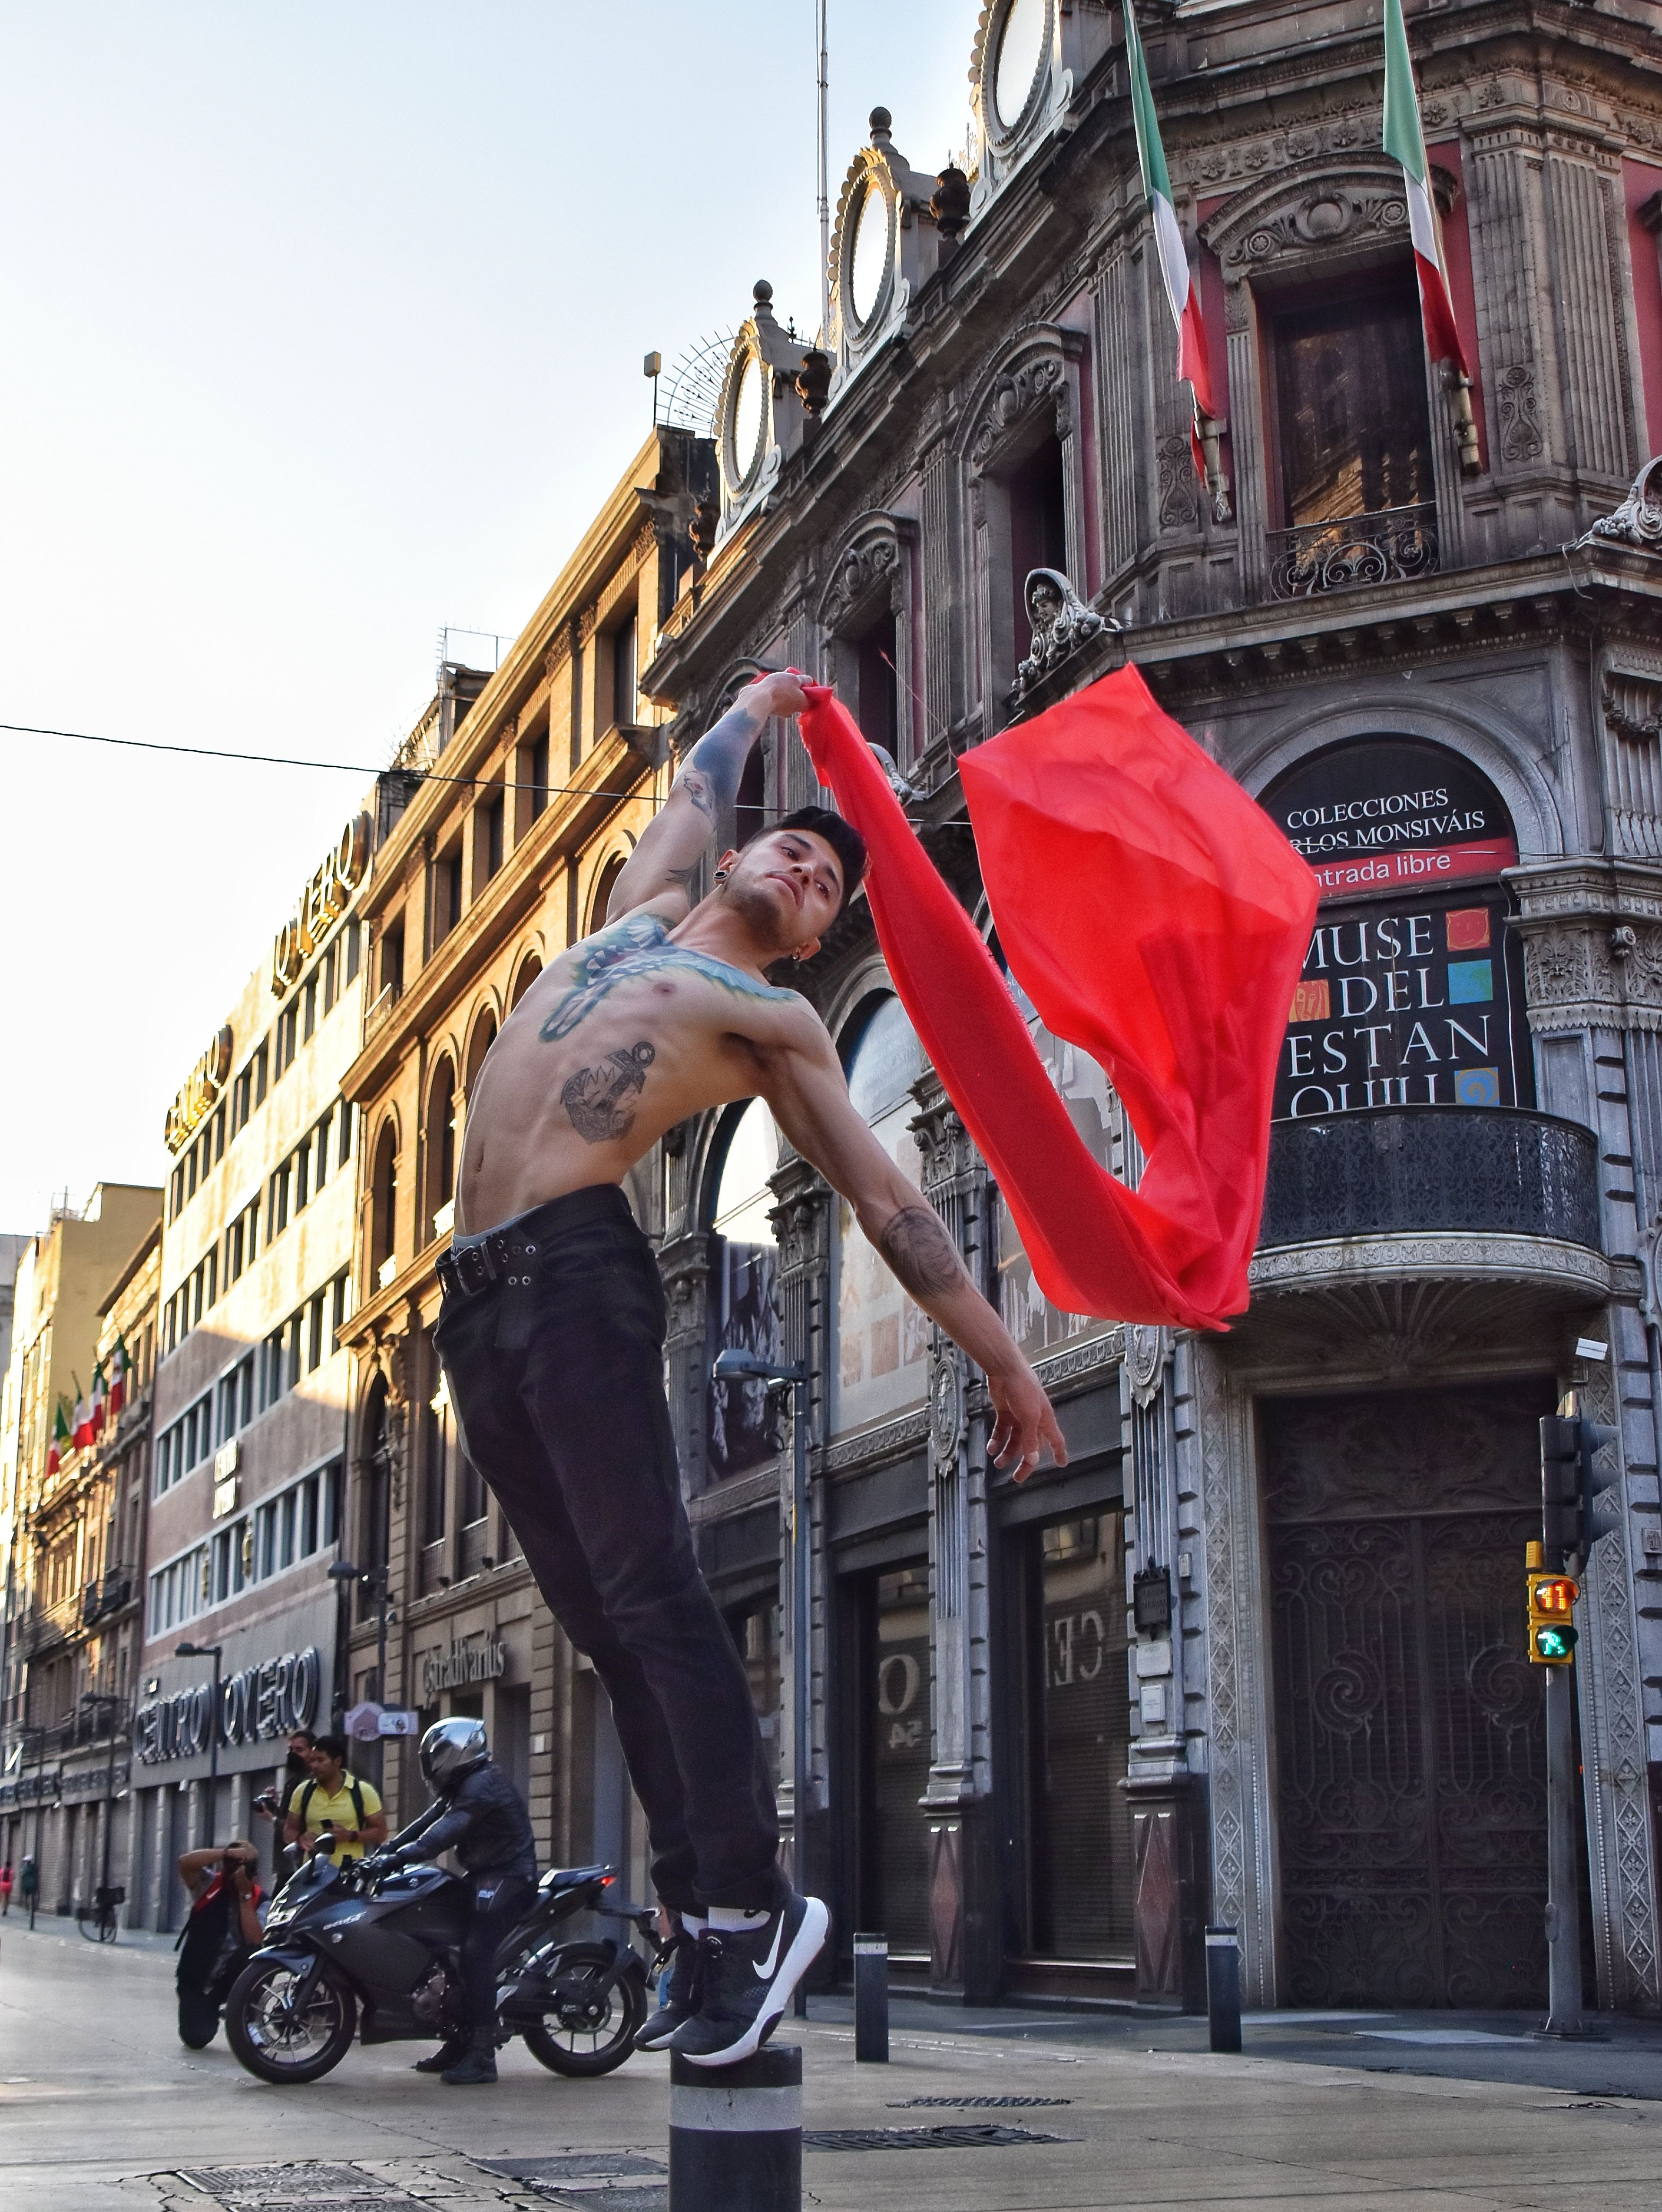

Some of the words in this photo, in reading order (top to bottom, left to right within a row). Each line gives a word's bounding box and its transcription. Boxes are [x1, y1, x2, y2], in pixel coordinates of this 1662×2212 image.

[1287, 788, 1449, 829] COLECCIONES
[1289, 831, 1349, 855] RLOS
[1355, 809, 1486, 846] MONSIVÁIS
[1315, 860, 1390, 888] ntrada
[1396, 854, 1452, 876] libre
[1337, 968, 1445, 1018] DEL
[1286, 1015, 1491, 1078] ESTAN
